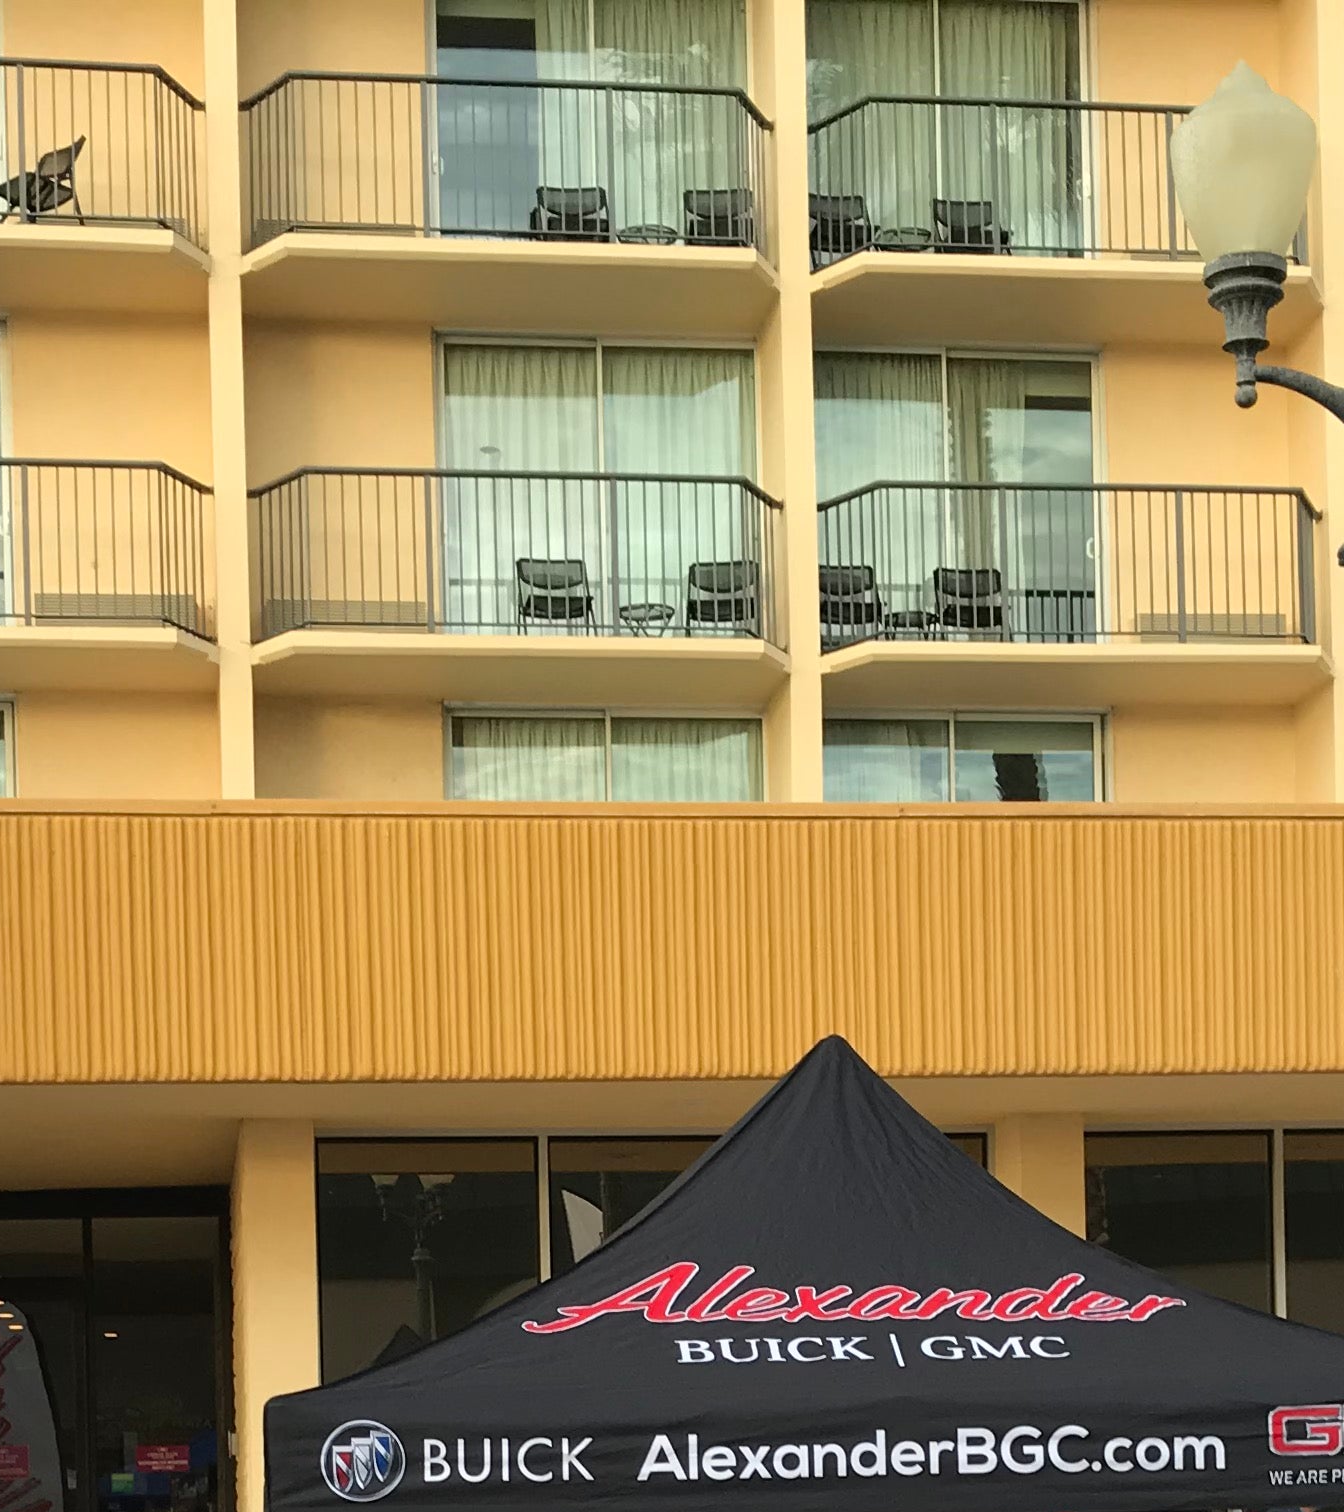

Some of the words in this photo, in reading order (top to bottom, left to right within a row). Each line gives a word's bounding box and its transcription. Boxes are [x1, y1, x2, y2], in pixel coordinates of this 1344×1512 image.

[521, 1262, 1186, 1334] Alexander
[675, 1335, 876, 1364] BUICK
[921, 1335, 1072, 1360] GMC
[423, 1435, 595, 1483] BUICK
[635, 1423, 1227, 1483] AlexanderBGC.com
[1269, 1469, 1293, 1486] WE
[1296, 1468, 1328, 1485] ARE
